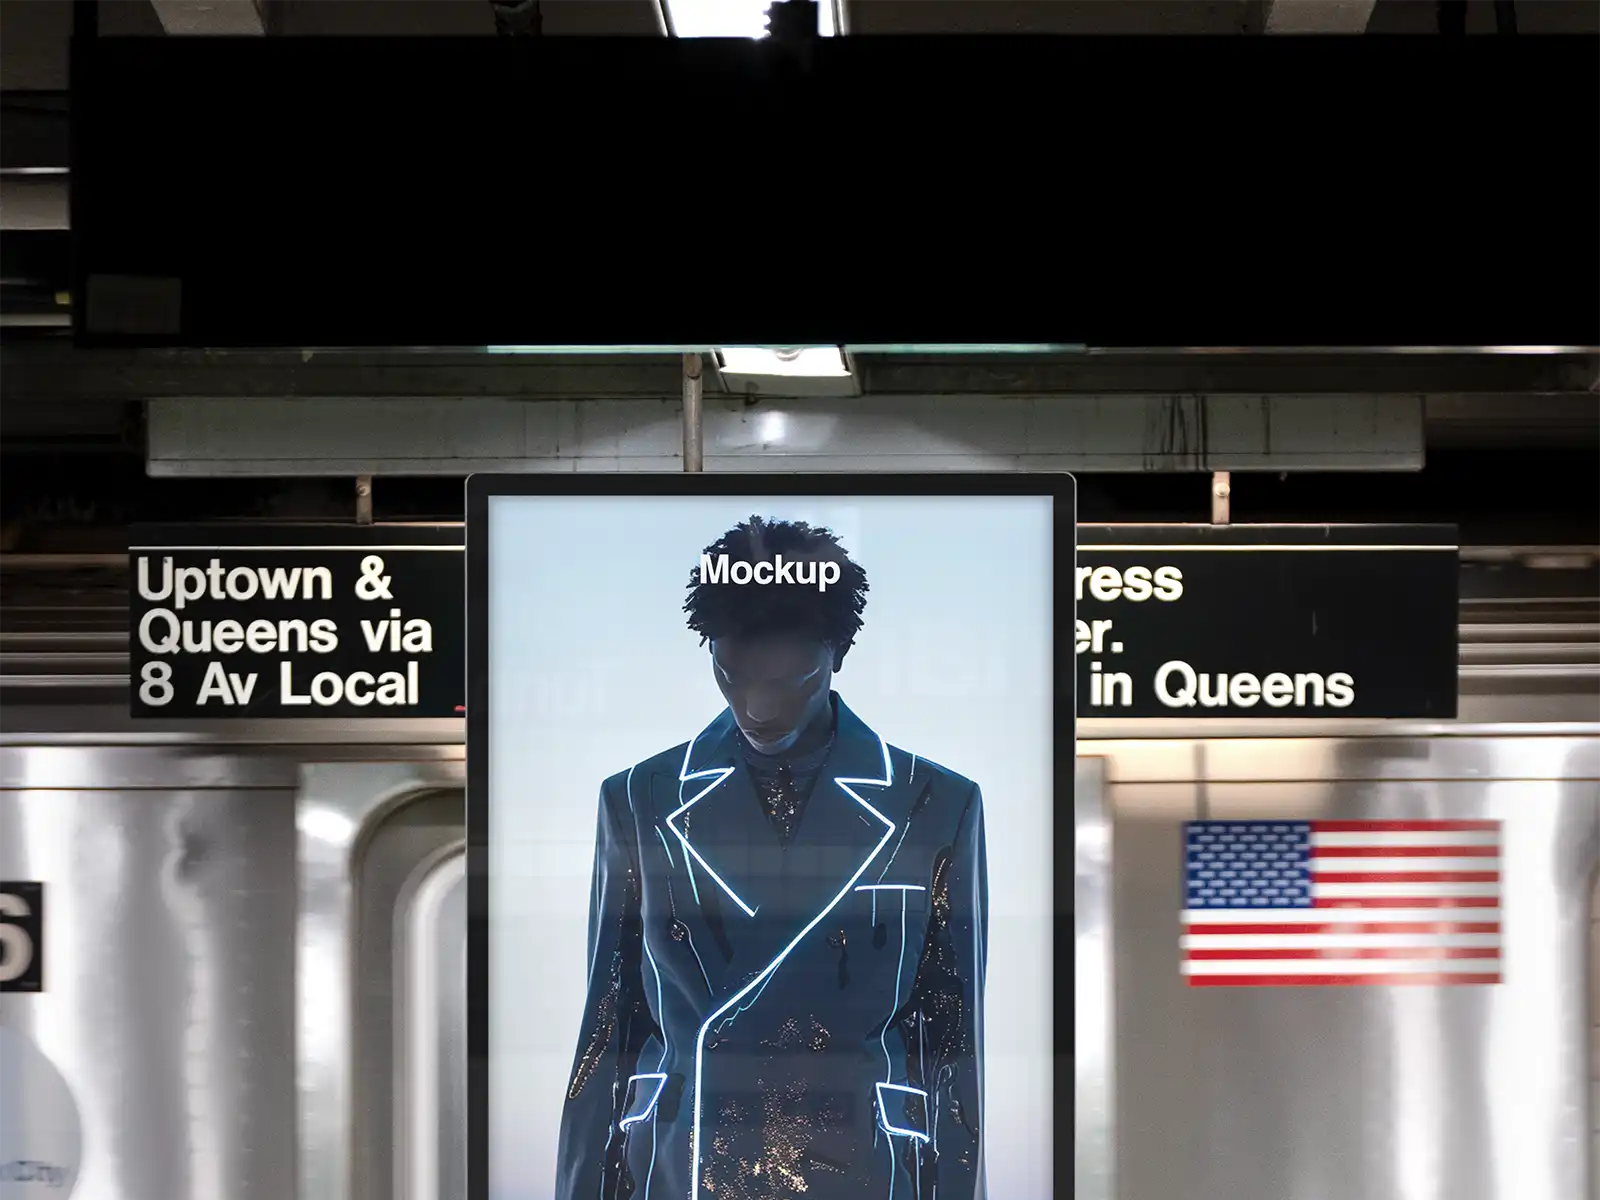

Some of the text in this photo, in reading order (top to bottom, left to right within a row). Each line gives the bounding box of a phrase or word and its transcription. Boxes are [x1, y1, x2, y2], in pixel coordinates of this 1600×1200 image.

[138, 555, 393, 609] Uptown &
[700, 554, 841, 592] Mockup
[139, 608, 432, 654] Queens via
[140, 661, 418, 705] 8 Av Local
[1091, 661, 1354, 707] in Queens
